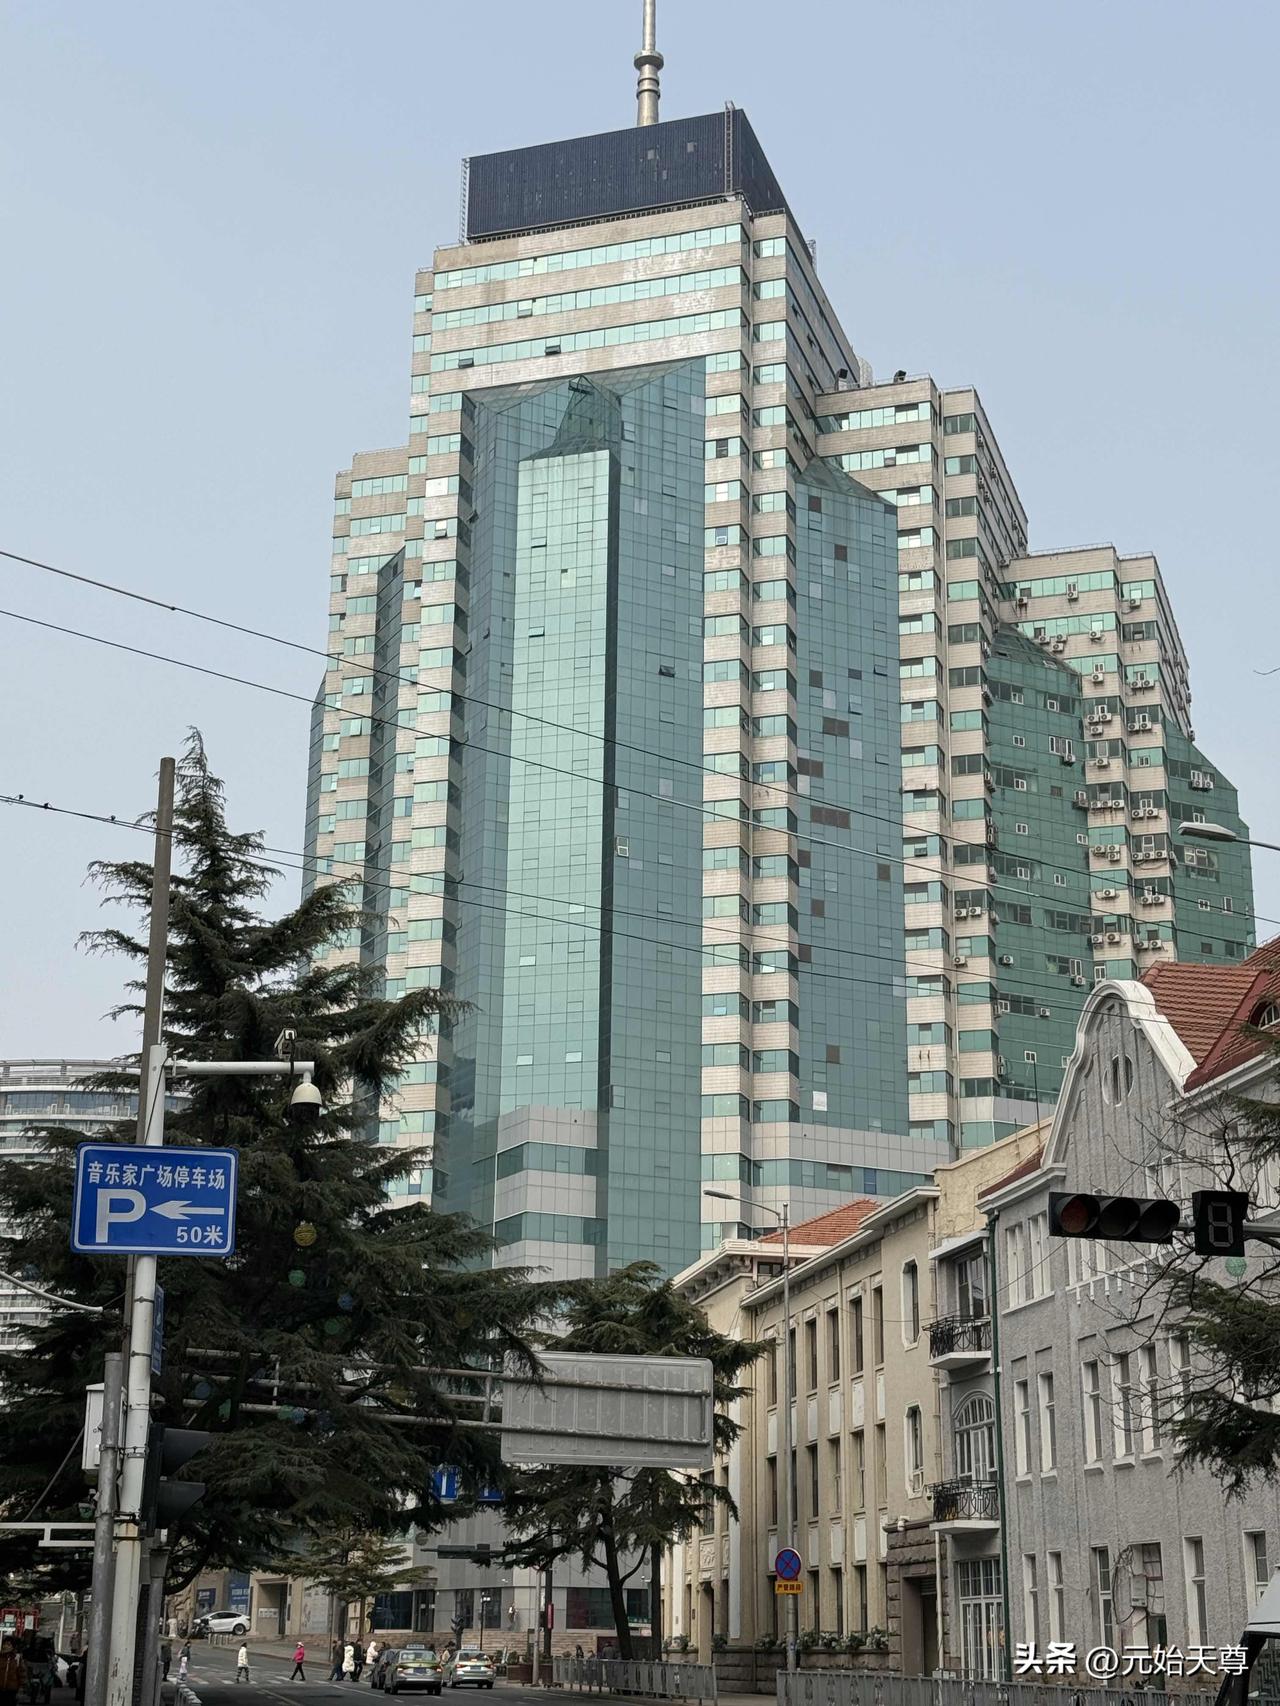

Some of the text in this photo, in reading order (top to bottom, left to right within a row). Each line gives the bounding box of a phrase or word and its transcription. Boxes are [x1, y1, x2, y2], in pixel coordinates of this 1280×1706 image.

[88, 1161, 225, 1190] 音乐家广场停车场
[95, 1188, 147, 1243] P
[176, 1224, 224, 1246] 50米
